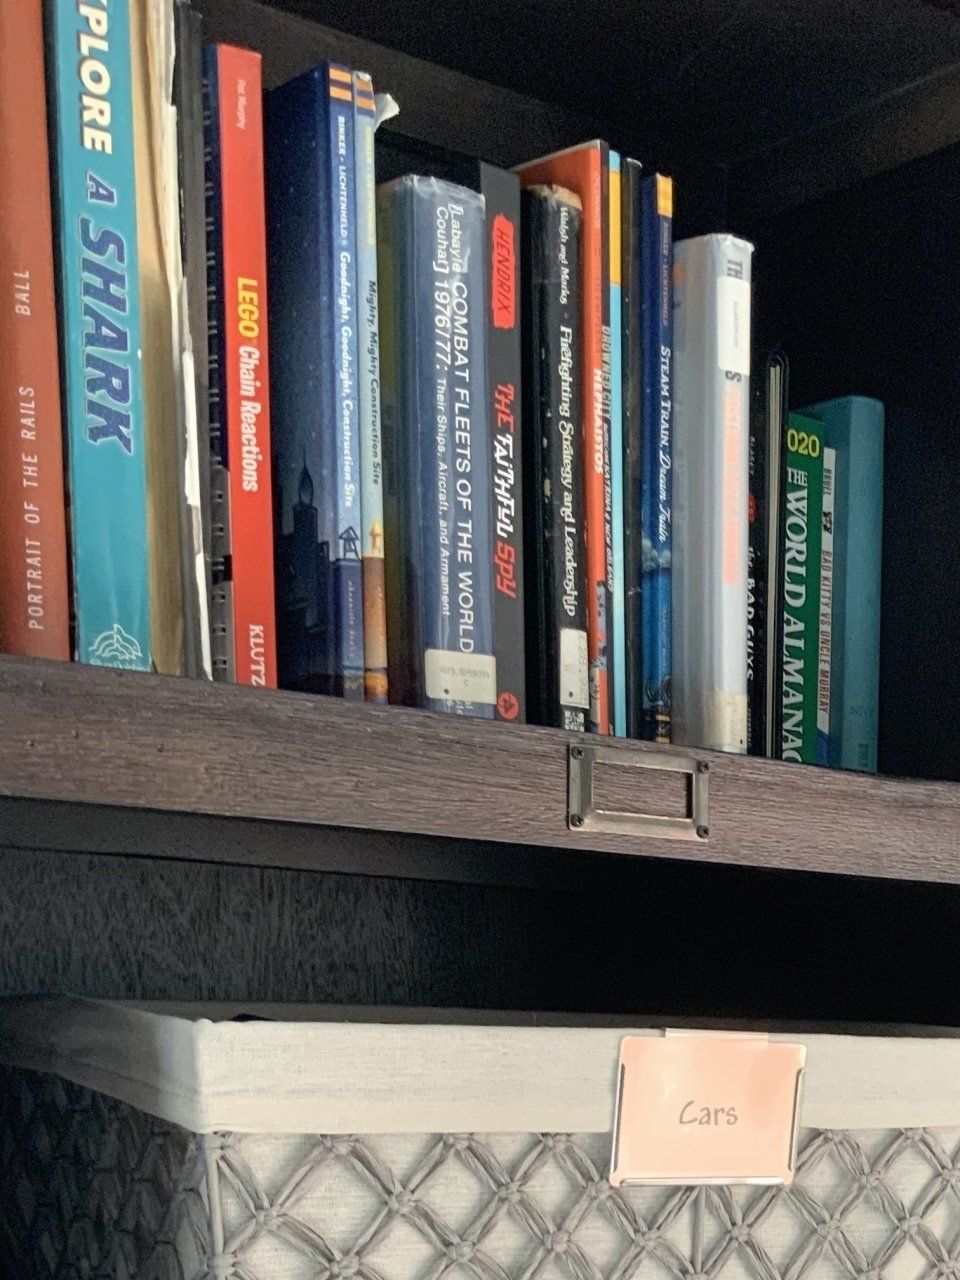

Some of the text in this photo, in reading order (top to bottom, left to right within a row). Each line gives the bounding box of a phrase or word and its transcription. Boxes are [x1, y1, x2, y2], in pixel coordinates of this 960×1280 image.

[78, 0, 133, 455] PLORE A SHARK
[339, 165, 348, 237] LICHTENHELD
[14, 269, 31, 316] BALL
[339, 252, 351, 322] Goodnight,
[496, 227, 511, 315] HENDRIX
[237, 276, 263, 493] LEGO Chain Reactions
[340, 326, 353, 397] Goodnight,
[366, 280, 381, 485] Mighty, Mighty Construction Site
[342, 400, 354, 481] Construction
[433, 205, 452, 616] Couhat] 1976/77: Their Ships, Aircraft, and Armament
[448, 203, 474, 653] [Labayle COMBAT FLEETS OF THE WORLD
[494, 383, 515, 434] THE
[558, 207, 578, 617] Walsh and Marks Firefighting Strategy and Leadership
[593, 368, 604, 475] HEPHAISTOS
[659, 346, 672, 543] STEAM TRAIN, Dream Train
[18, 386, 44, 630] PORTRAIT OF THE RAILS
[344, 482, 355, 508] Site
[603, 464, 612, 512] KATRINA
[787, 467, 808, 487] THE
[784, 487, 808, 608] WORLD
[747, 578, 756, 620] BAD
[818, 550, 832, 714] BAD KITTY VS UNCLE MURRAY
[249, 624, 266, 687] KLUTZ
[747, 625, 755, 681] GUYS
[678, 1100, 739, 1126] Cars
